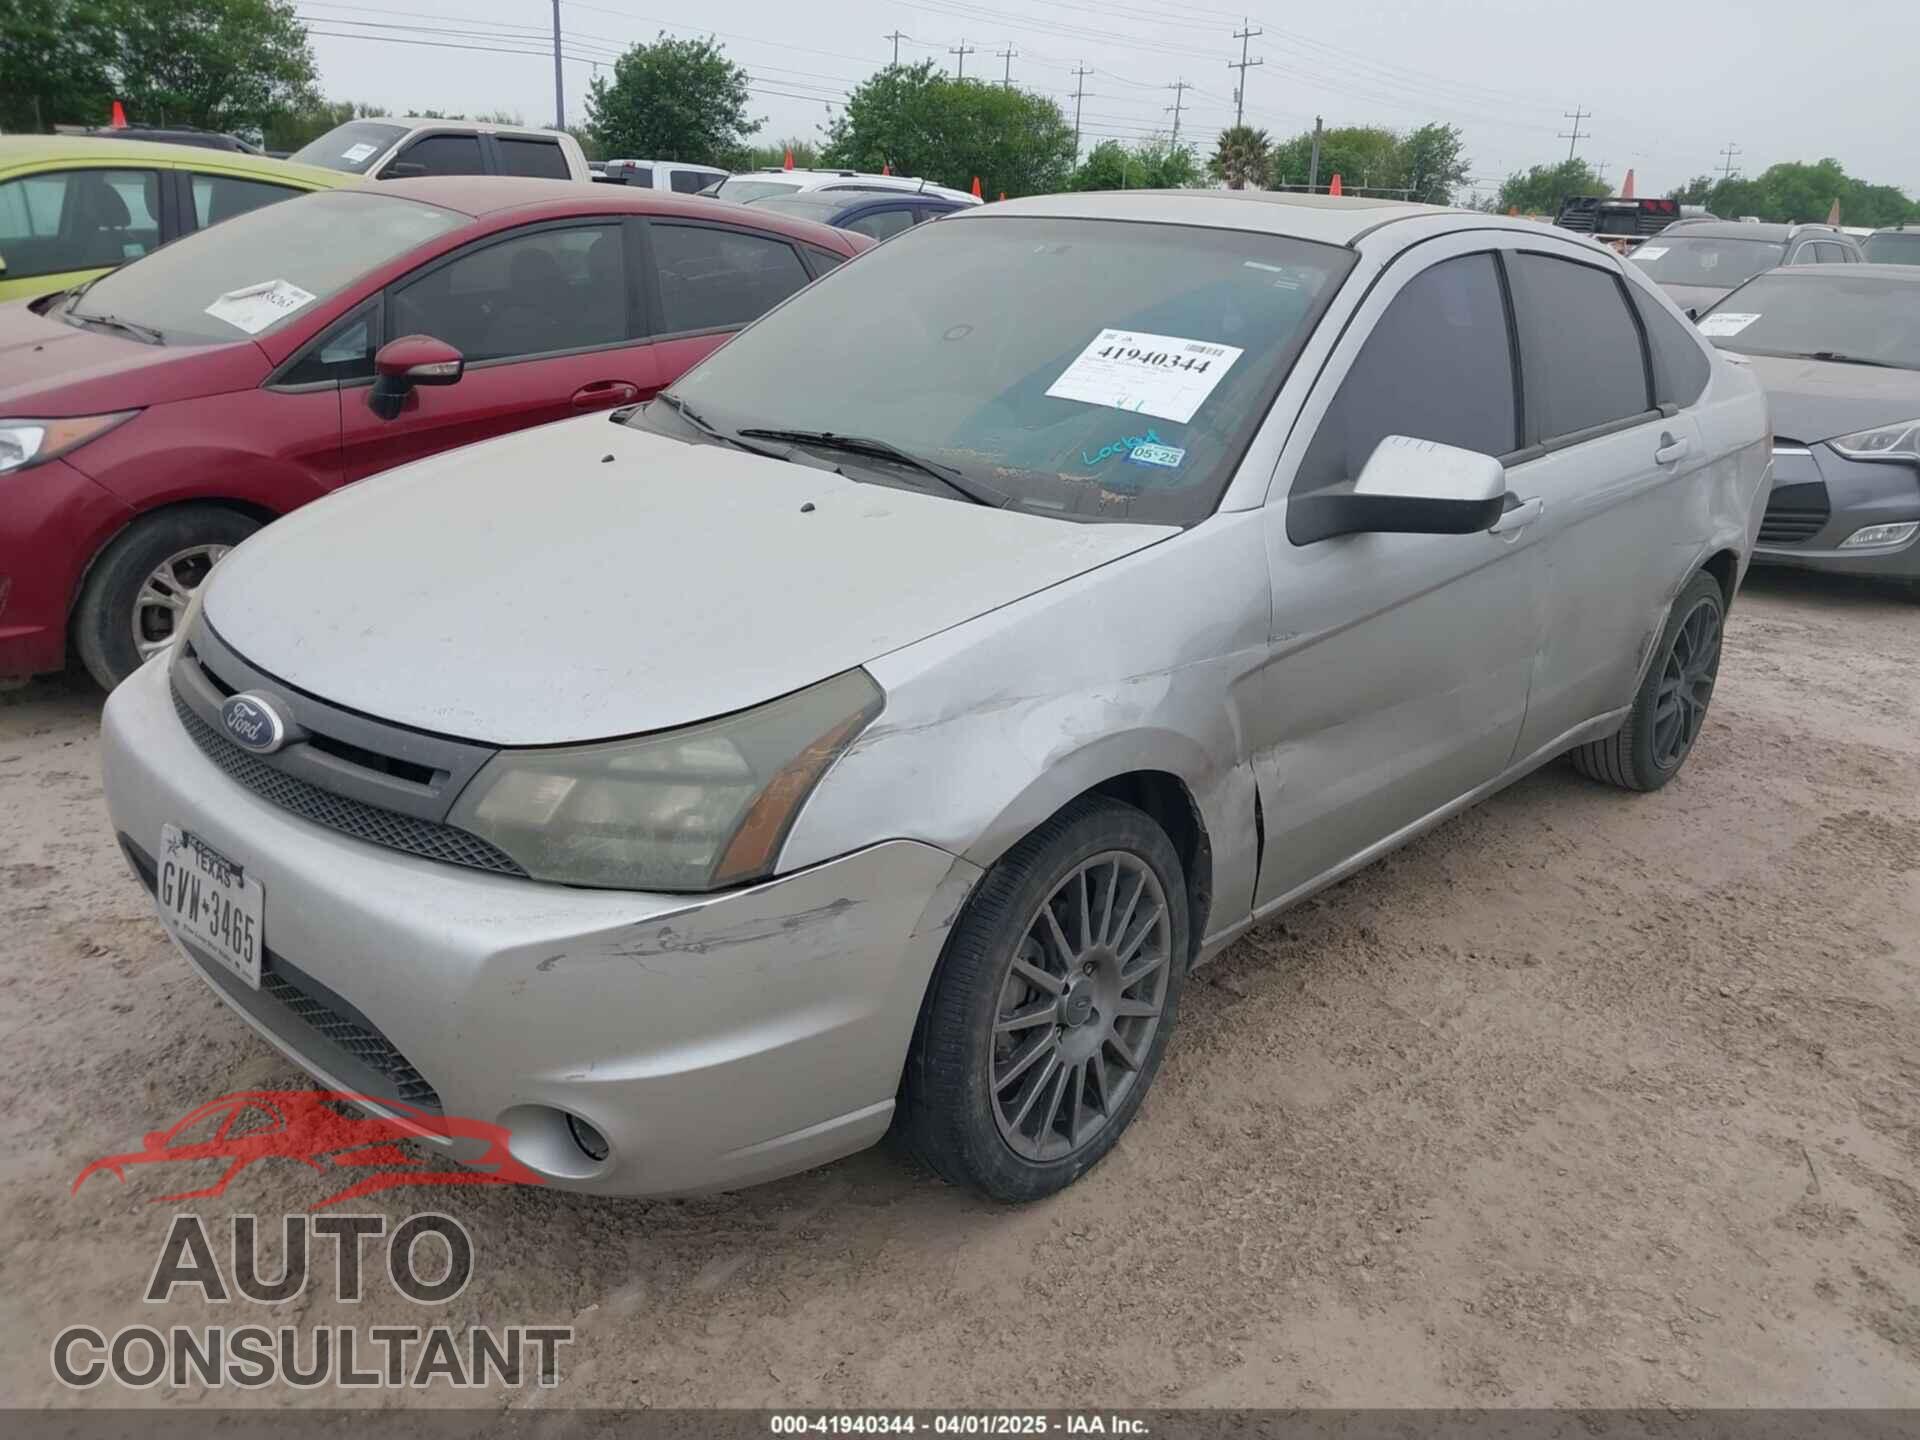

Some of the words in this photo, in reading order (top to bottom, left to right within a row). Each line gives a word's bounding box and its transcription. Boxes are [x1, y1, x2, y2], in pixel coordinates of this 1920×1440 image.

[1097, 345, 1211, 374] 41940344
[227, 702, 263, 740] Ford
[194, 847, 231, 888] TEXAS
